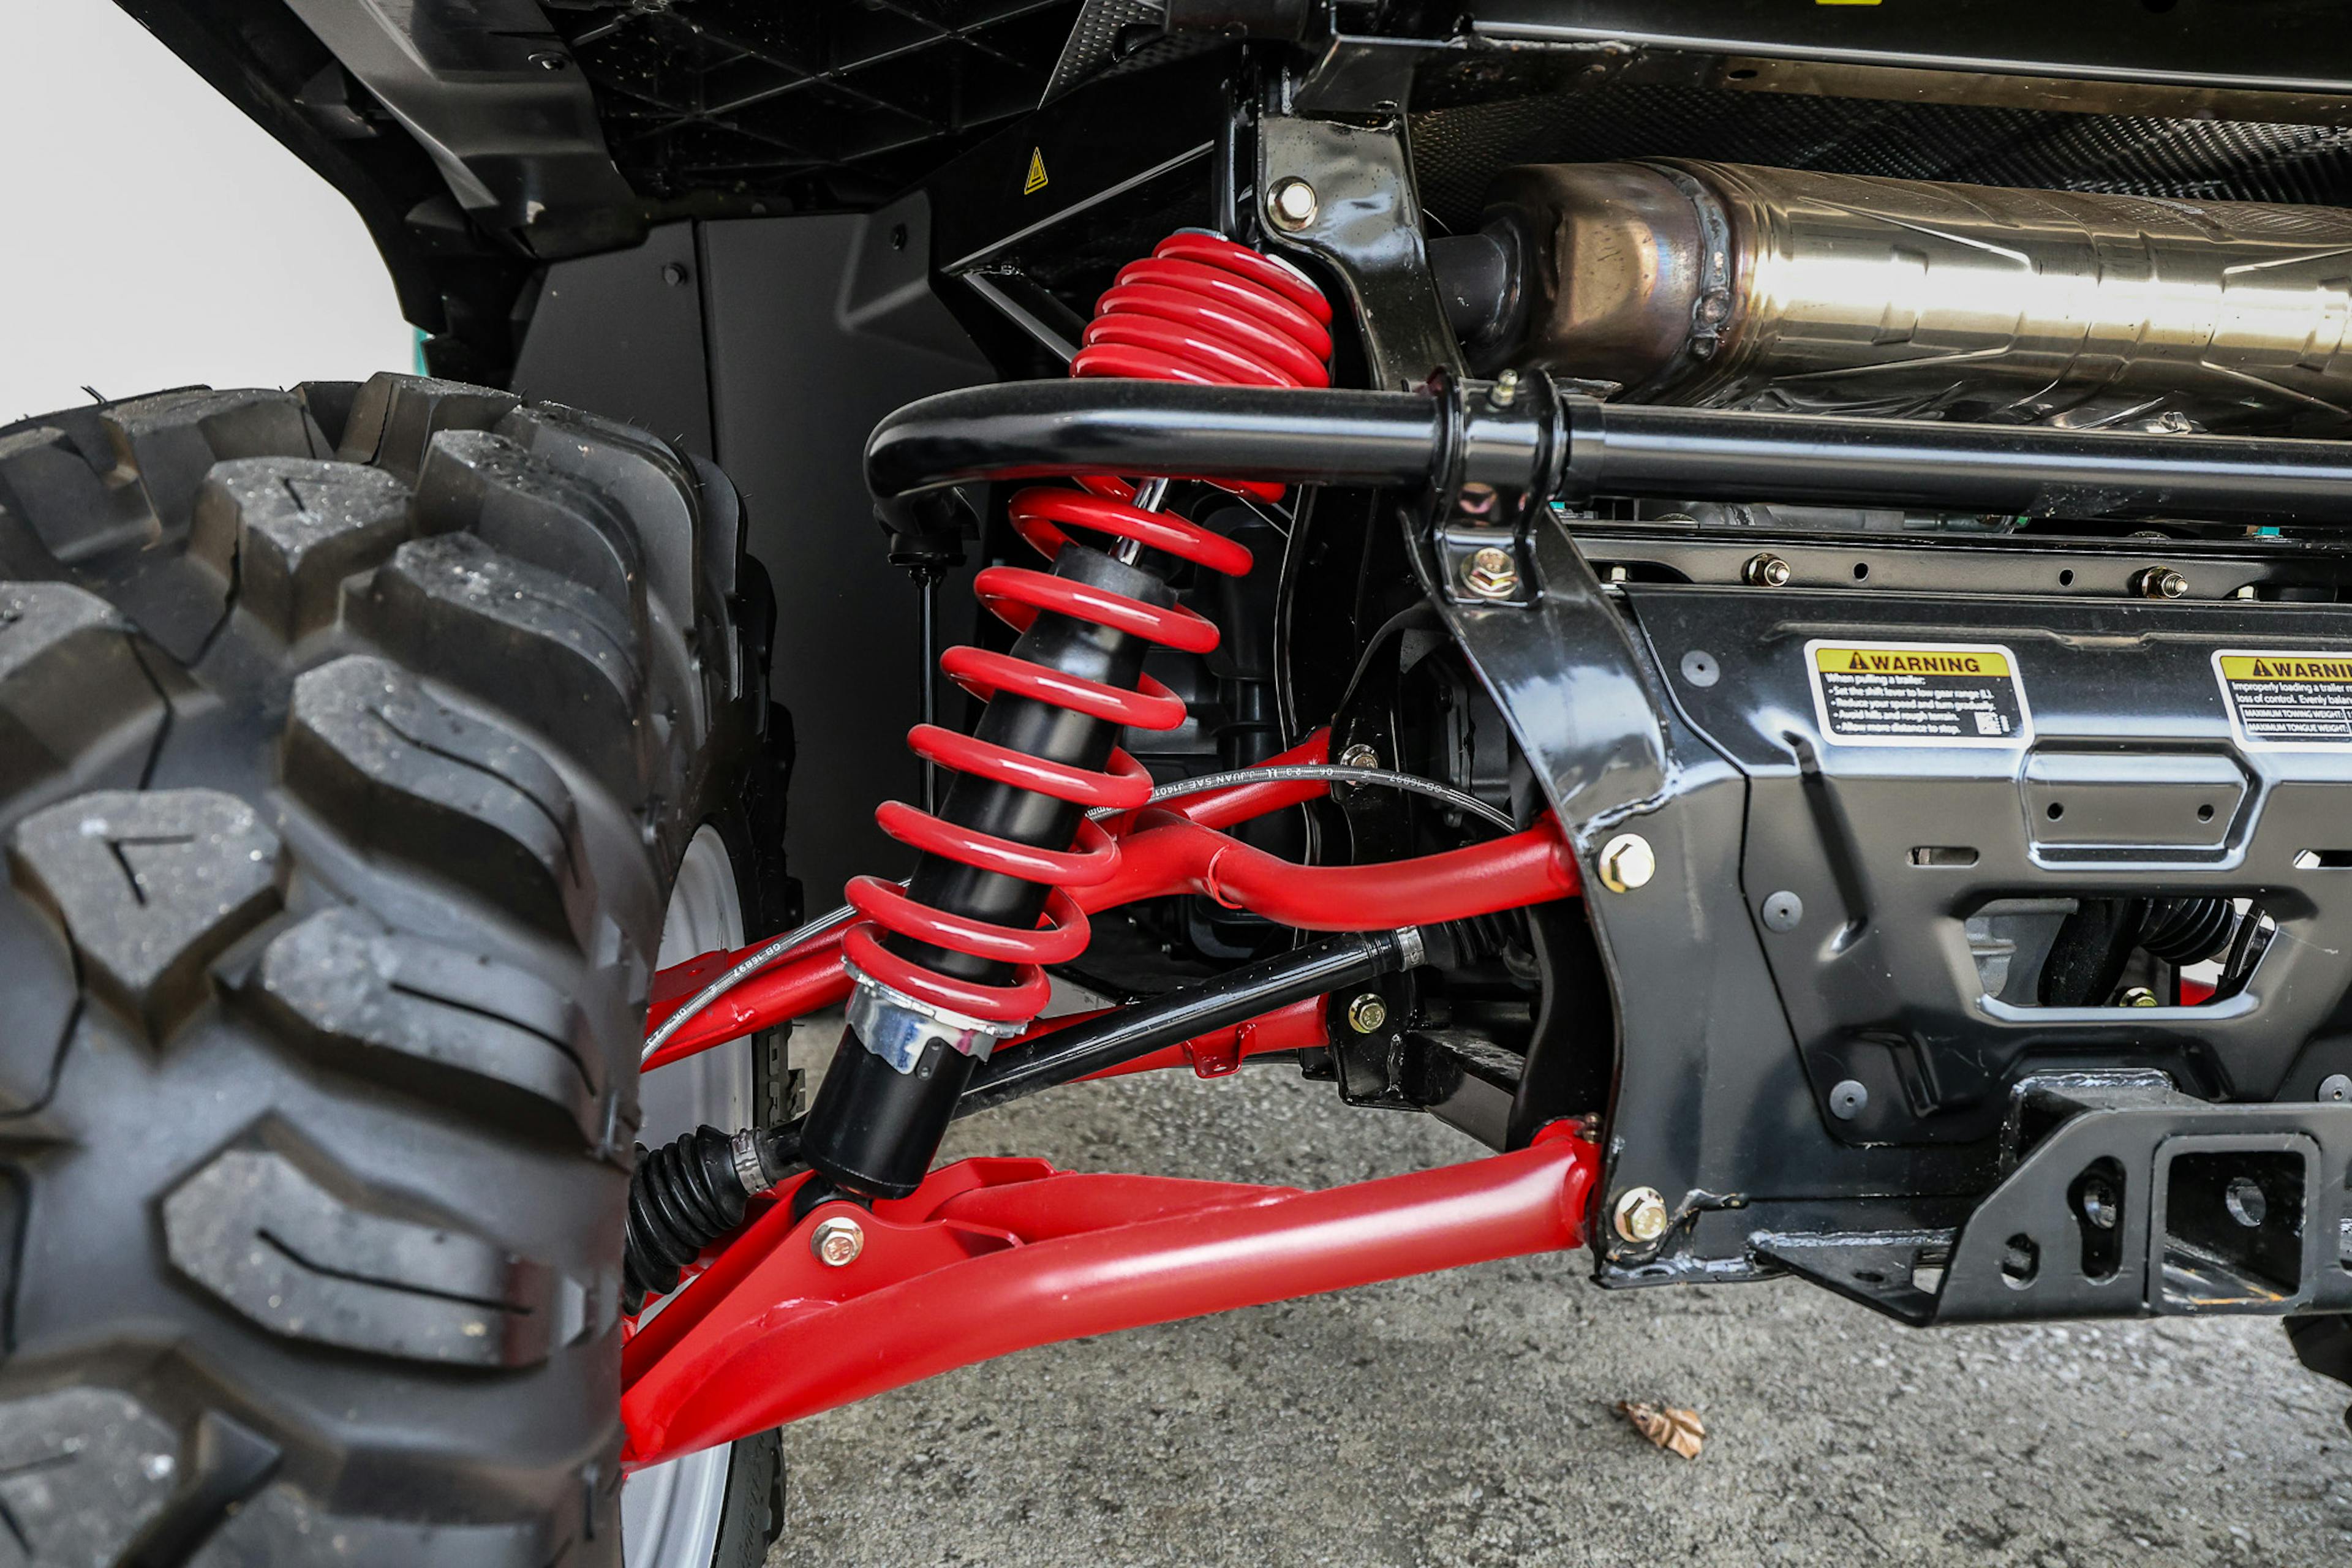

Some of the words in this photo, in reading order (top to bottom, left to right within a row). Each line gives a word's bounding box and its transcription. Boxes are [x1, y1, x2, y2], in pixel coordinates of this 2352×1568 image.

[1870, 655, 1980, 673] WARNING
[1825, 673, 1855, 683] When
[1855, 674, 1888, 686] pulling
[1833, 685, 1849, 696] Set
[1849, 686, 1864, 696] the
[1864, 687, 1884, 696] shift
[1906, 688, 1917, 697] to
[1916, 687, 1934, 697] low
[2231, 682, 2278, 693] Improperly
[2278, 682, 2313, 693] loading
[2320, 683, 2345, 692] trailer
[2236, 693, 2253, 703] loss
[2253, 693, 2264, 703] of
[2263, 695, 2298, 704] control.
[2298, 695, 2327, 706] Evenly
[2244, 709, 2283, 718] MAXIMUM
[2282, 710, 2313, 718] TOWING
[2247, 723, 2288, 732] MAXIMUM
[2287, 723, 2318, 733] TONGUE
[1188, 777, 1212, 789] SAE
